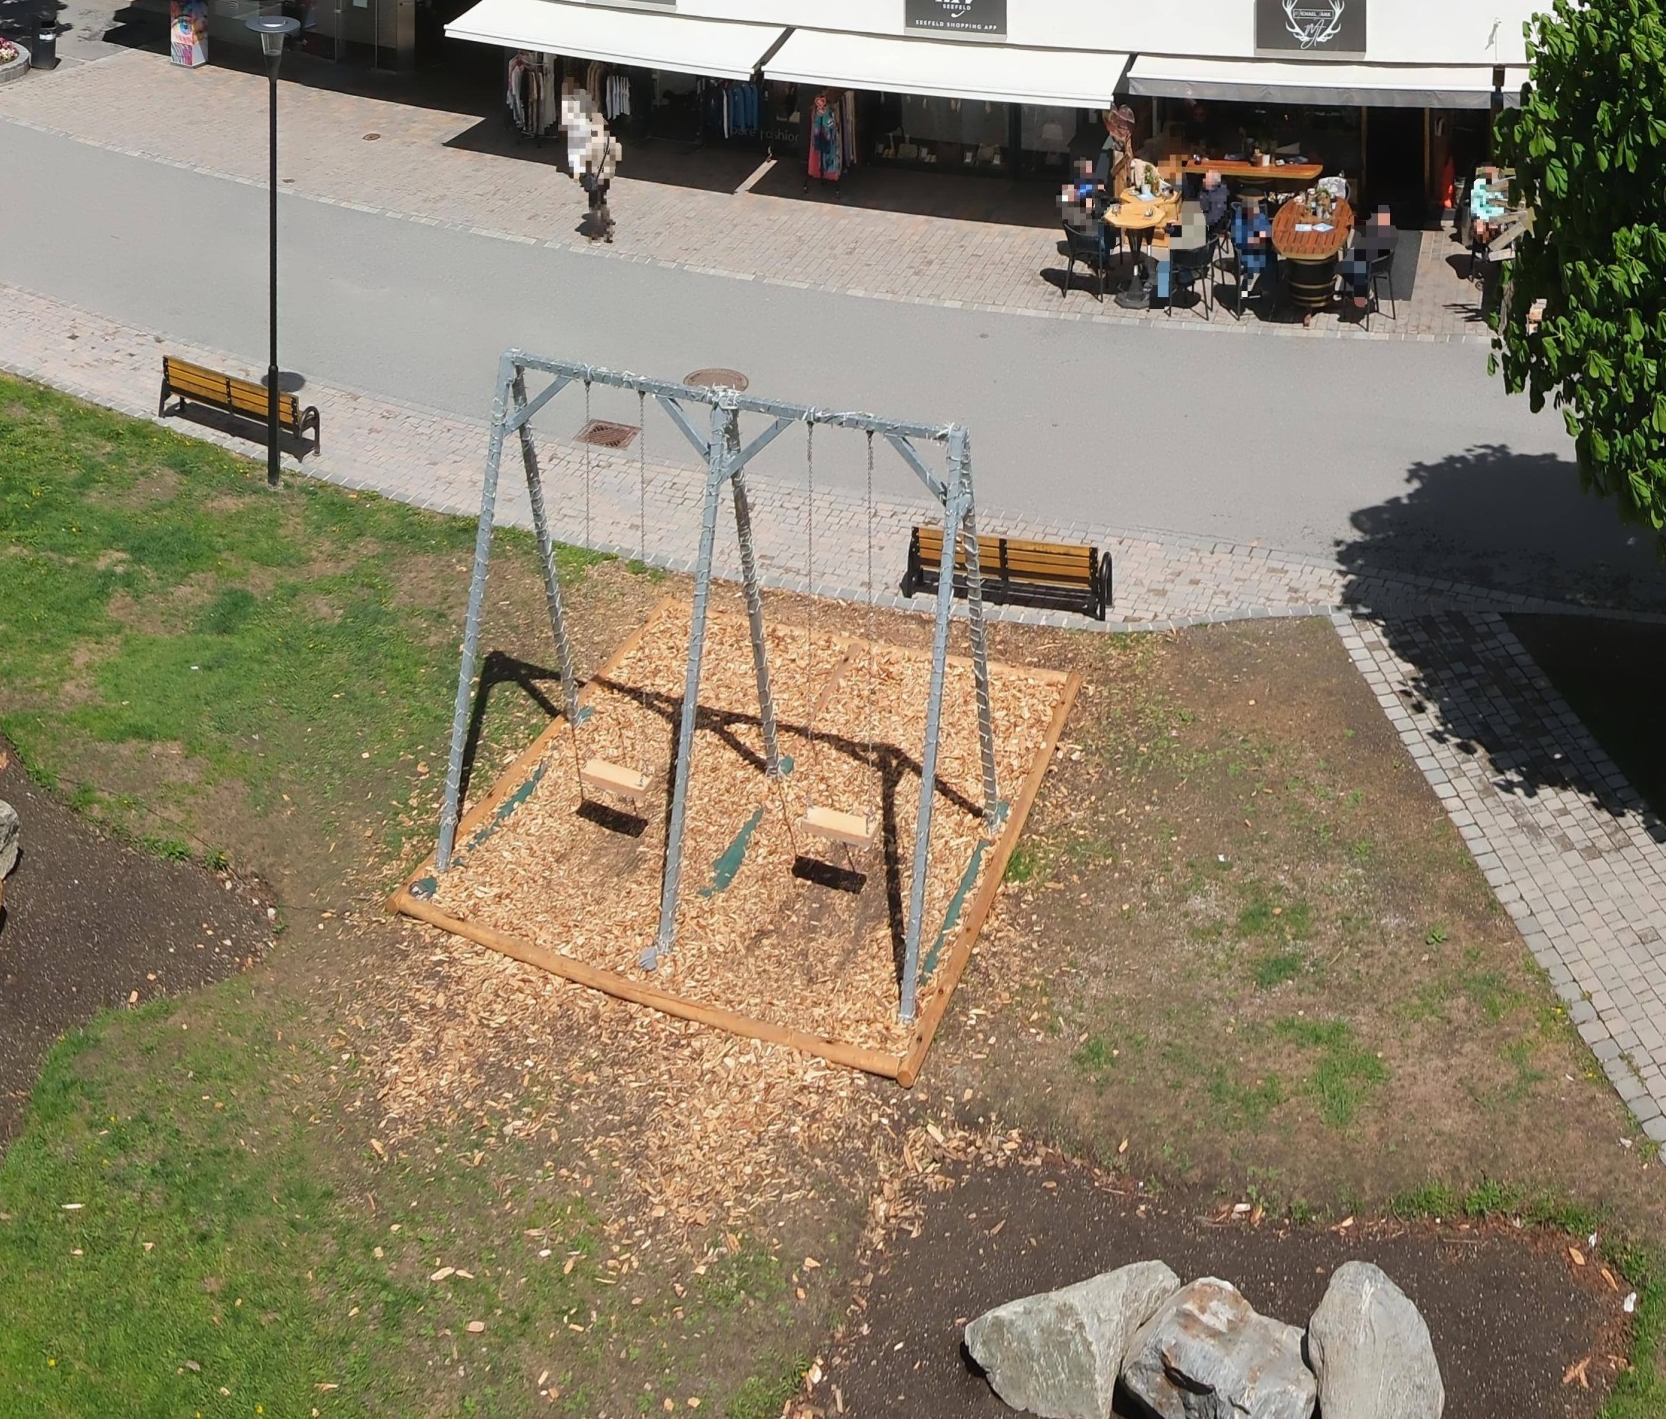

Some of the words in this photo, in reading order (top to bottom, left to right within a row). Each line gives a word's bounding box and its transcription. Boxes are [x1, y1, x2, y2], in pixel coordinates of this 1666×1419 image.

[942, 3, 972, 11] SEEFELD
[915, 19, 945, 27] SEEFELD
[946, 21, 982, 30] SHOPPING
